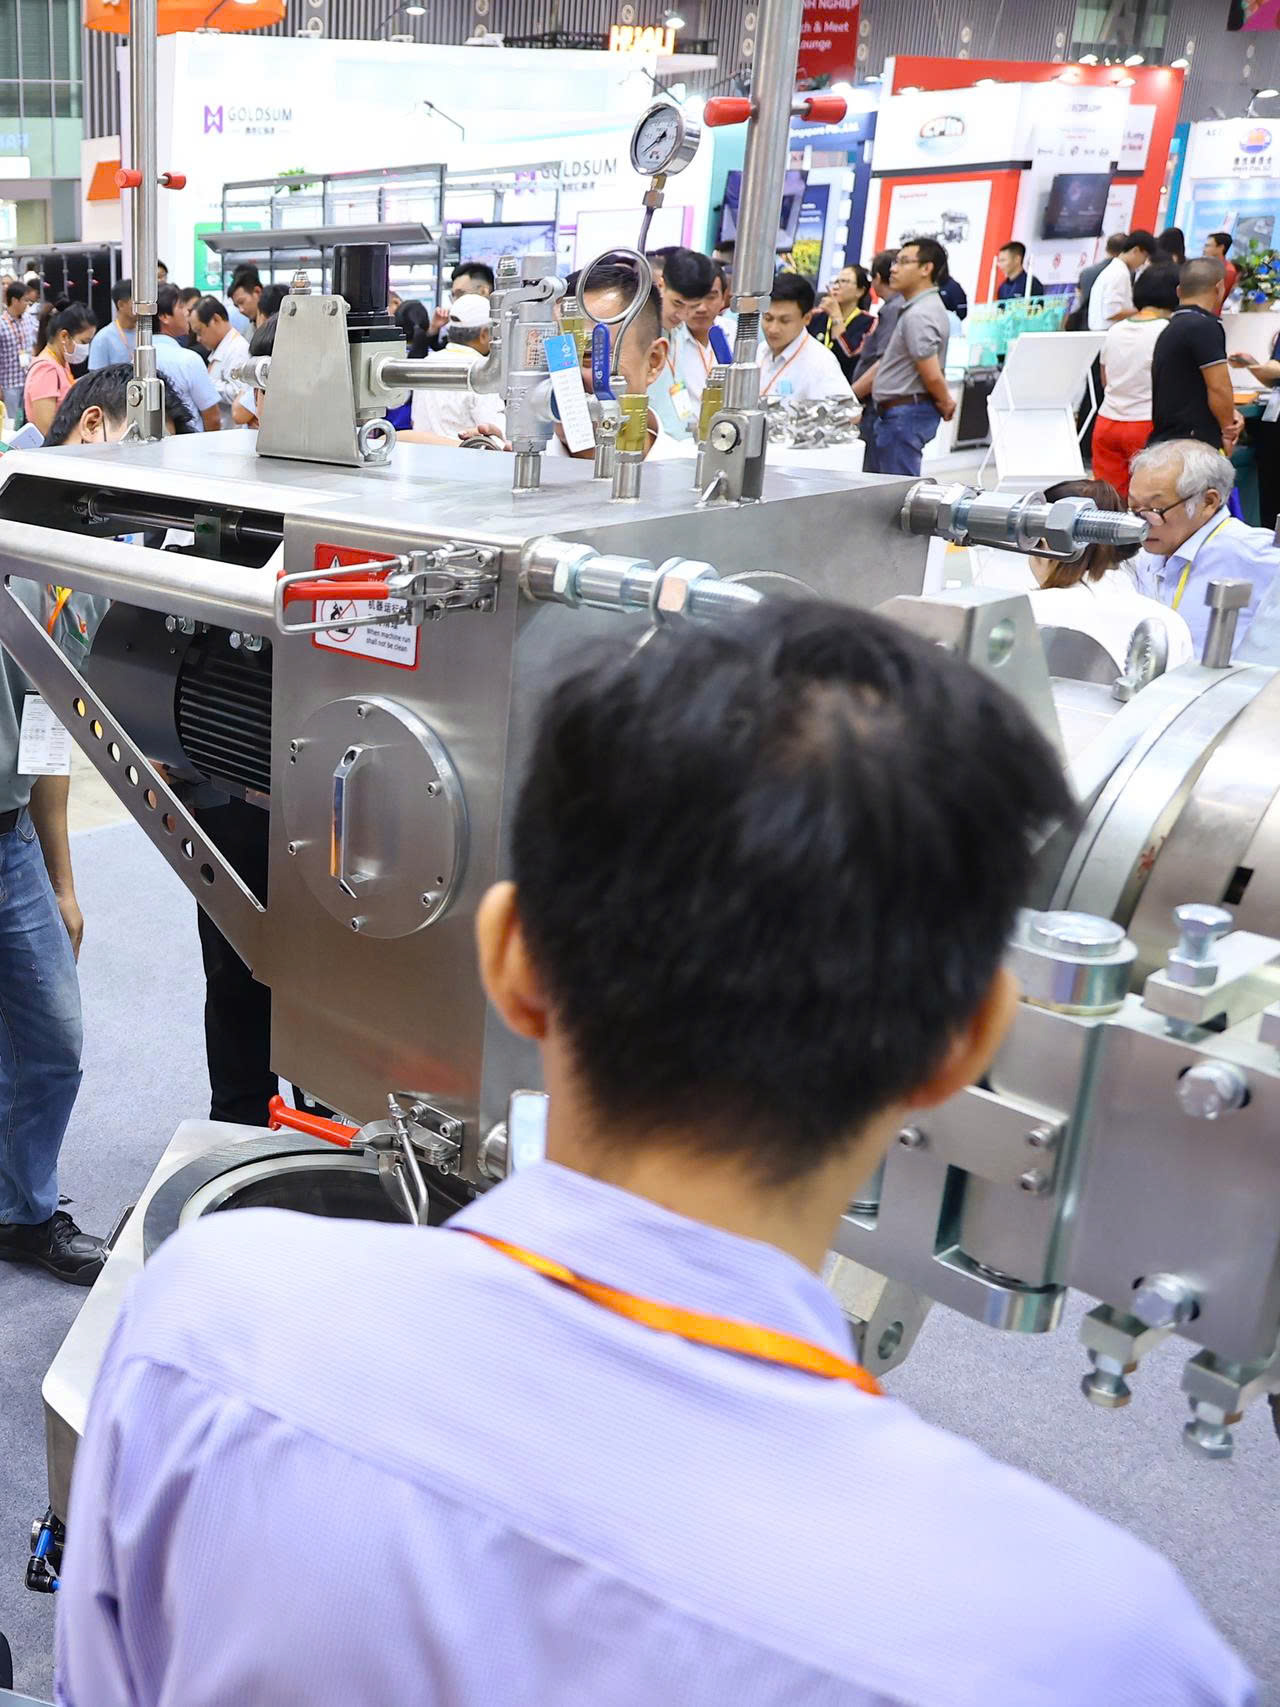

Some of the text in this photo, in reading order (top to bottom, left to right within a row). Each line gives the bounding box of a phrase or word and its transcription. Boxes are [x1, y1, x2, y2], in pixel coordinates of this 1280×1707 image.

[824, 21, 849, 32] Meet
[800, 40, 832, 52] ounge
[227, 106, 292, 122] GOLDSUM
[541, 158, 617, 179] GOLDSUM
[367, 628, 380, 636] When
[381, 631, 401, 641] machine
[366, 637, 378, 645] shall
